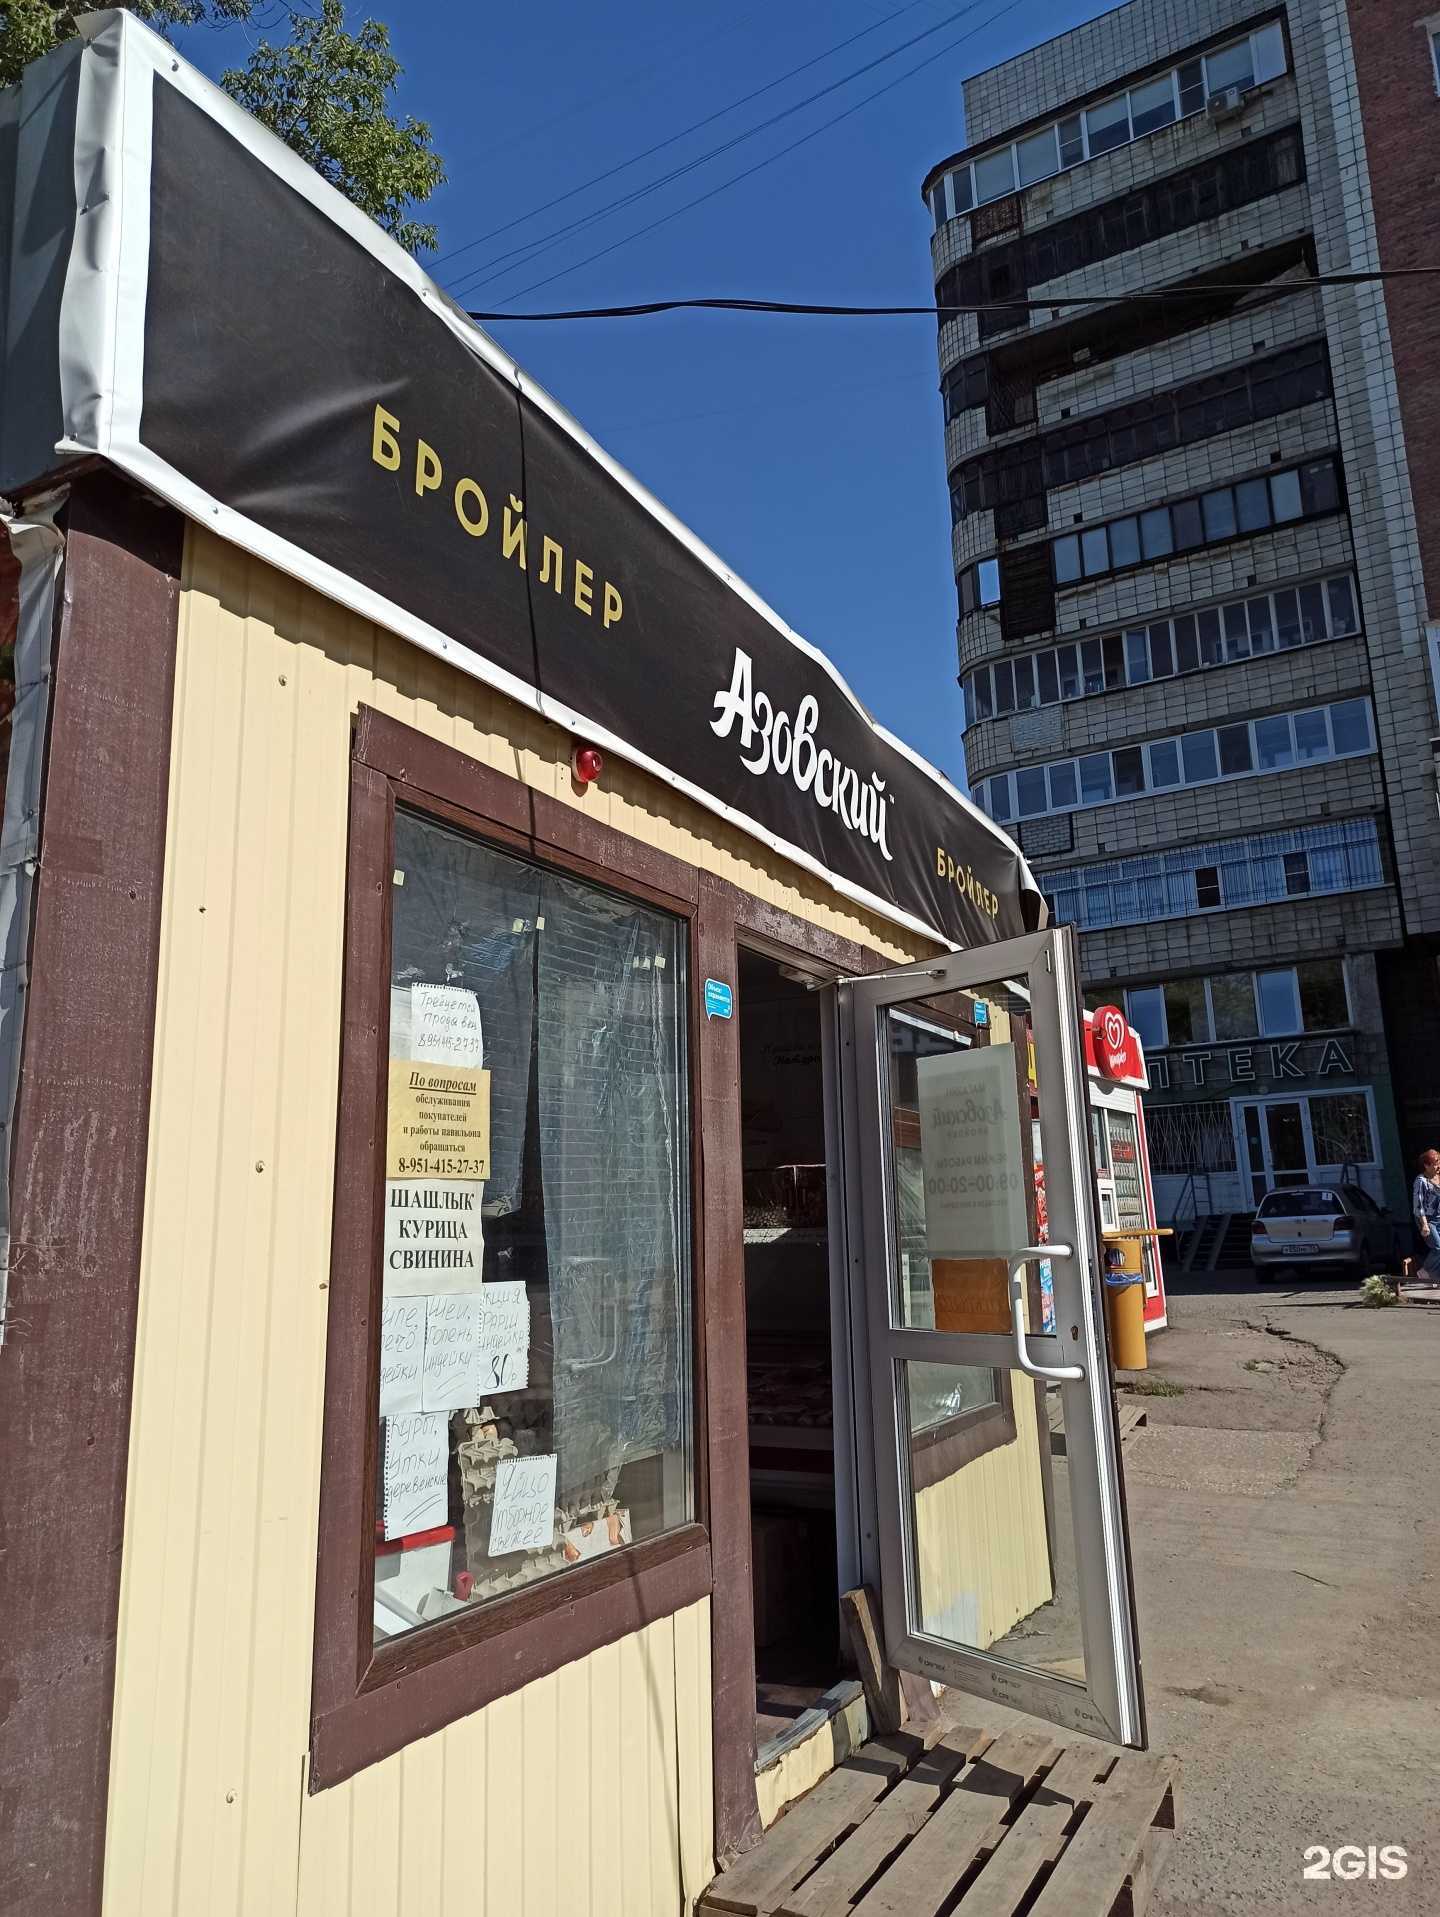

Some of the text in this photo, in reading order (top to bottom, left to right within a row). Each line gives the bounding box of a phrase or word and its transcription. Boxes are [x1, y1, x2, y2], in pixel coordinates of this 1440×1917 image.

[371, 403, 623, 629] БРОЙЛЕР
[709, 647, 893, 861] Азовский
[936, 847, 999, 920] БРОЙЛЕР
[1146, 1039, 1353, 1088] ПТЕКА
[409, 1071, 477, 1094] По вопросам
[415, 1093, 471, 1108] обслуживания
[419, 1111, 467, 1123] покупателей
[410, 1124, 440, 1137] работы
[441, 1128, 481, 1138] павильона
[419, 1140, 466, 1154] обращаться
[398, 1157, 485, 1174] 8-951-415-27-37
[390, 1188, 475, 1211] ШАШЛЫК
[399, 1219, 469, 1244] КУРИЦА
[389, 1249, 474, 1270] СВИНИНА
